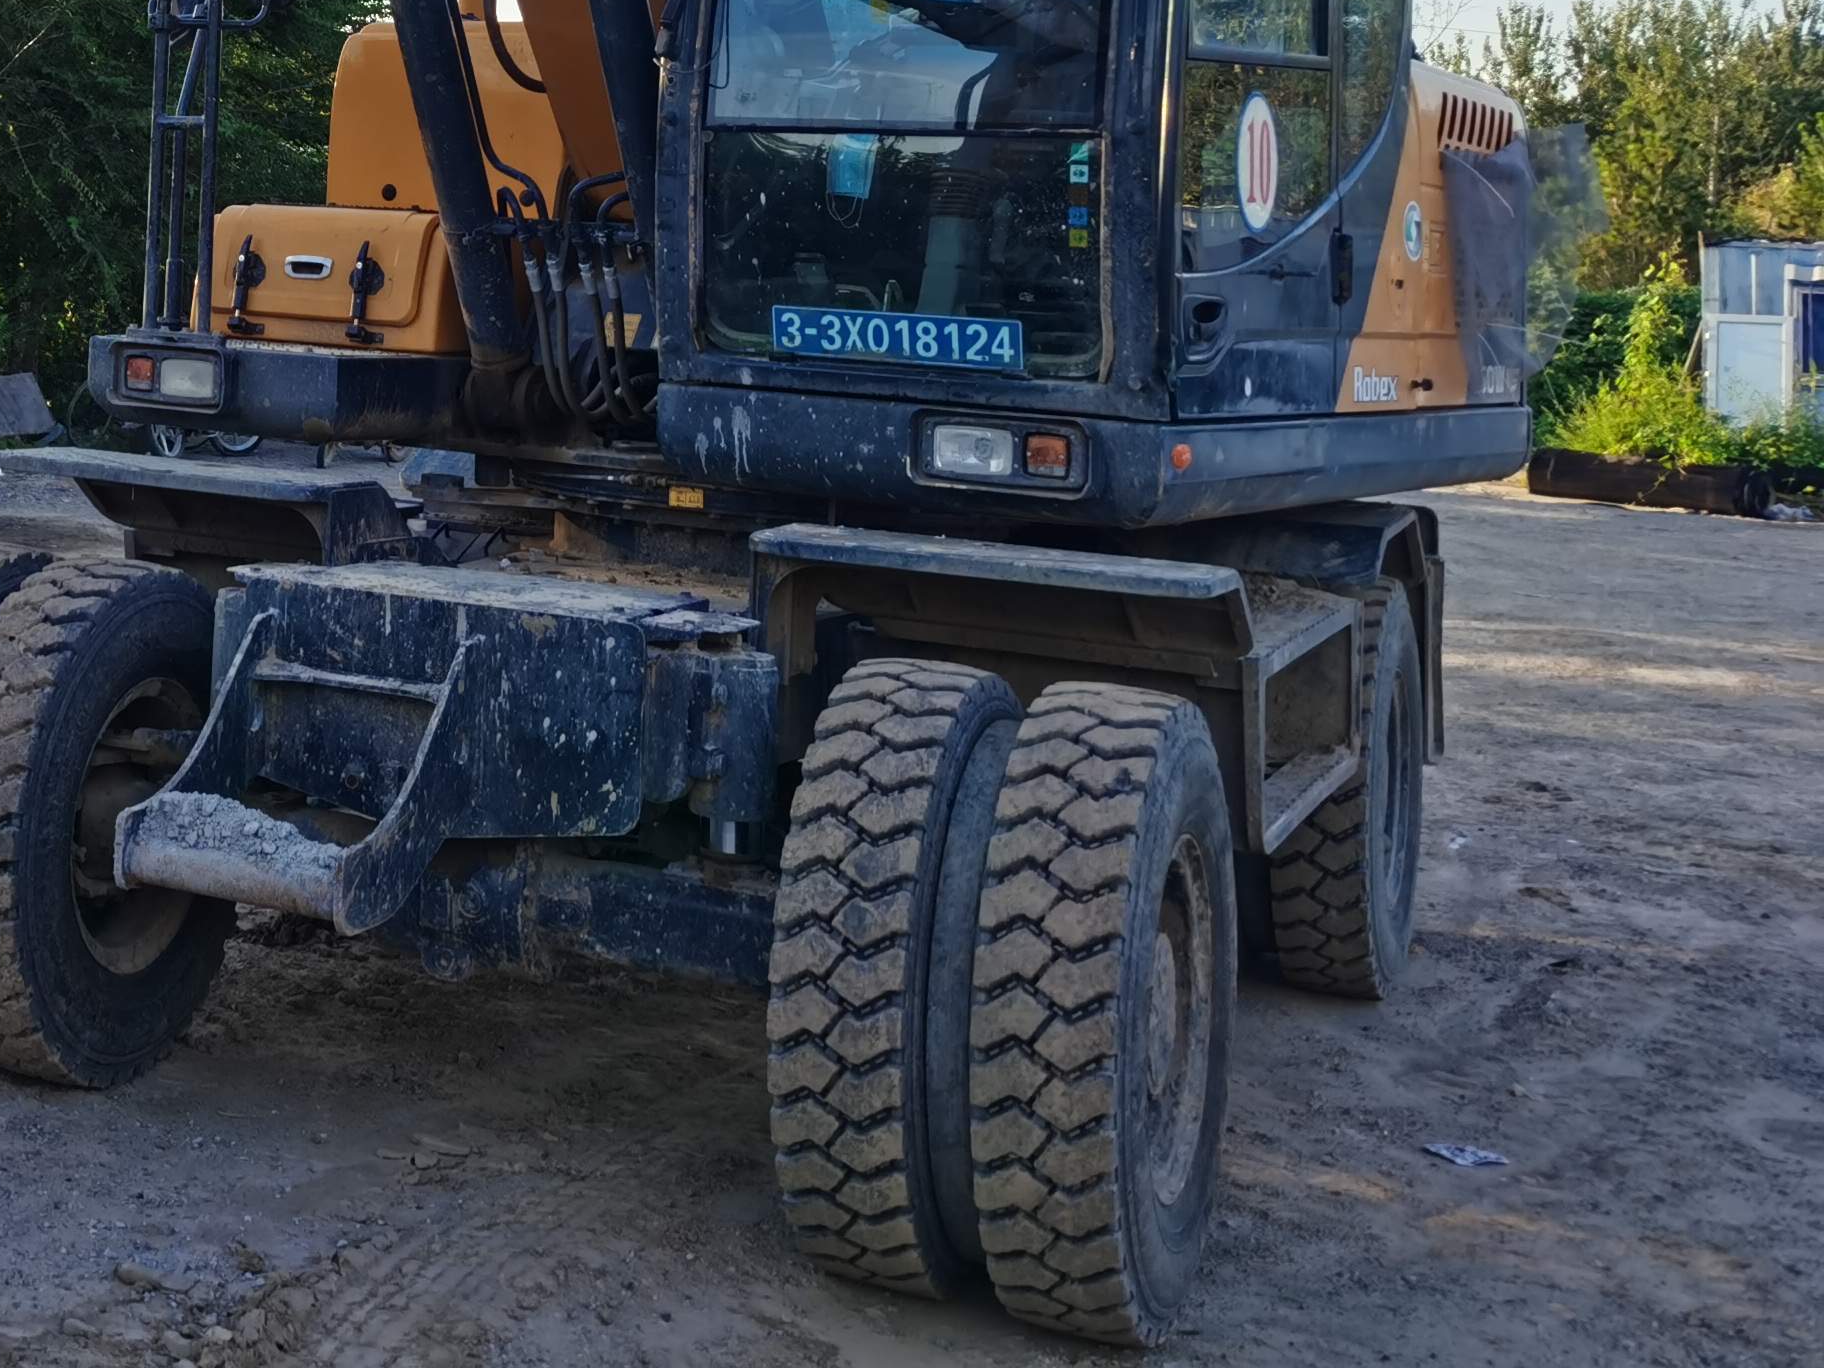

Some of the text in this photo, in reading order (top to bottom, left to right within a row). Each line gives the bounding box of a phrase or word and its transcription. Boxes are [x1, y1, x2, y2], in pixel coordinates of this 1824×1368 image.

[1247, 118, 1271, 205] 10
[780, 312, 1015, 363] 3-3X018124
[1353, 366, 1398, 403] Robex
